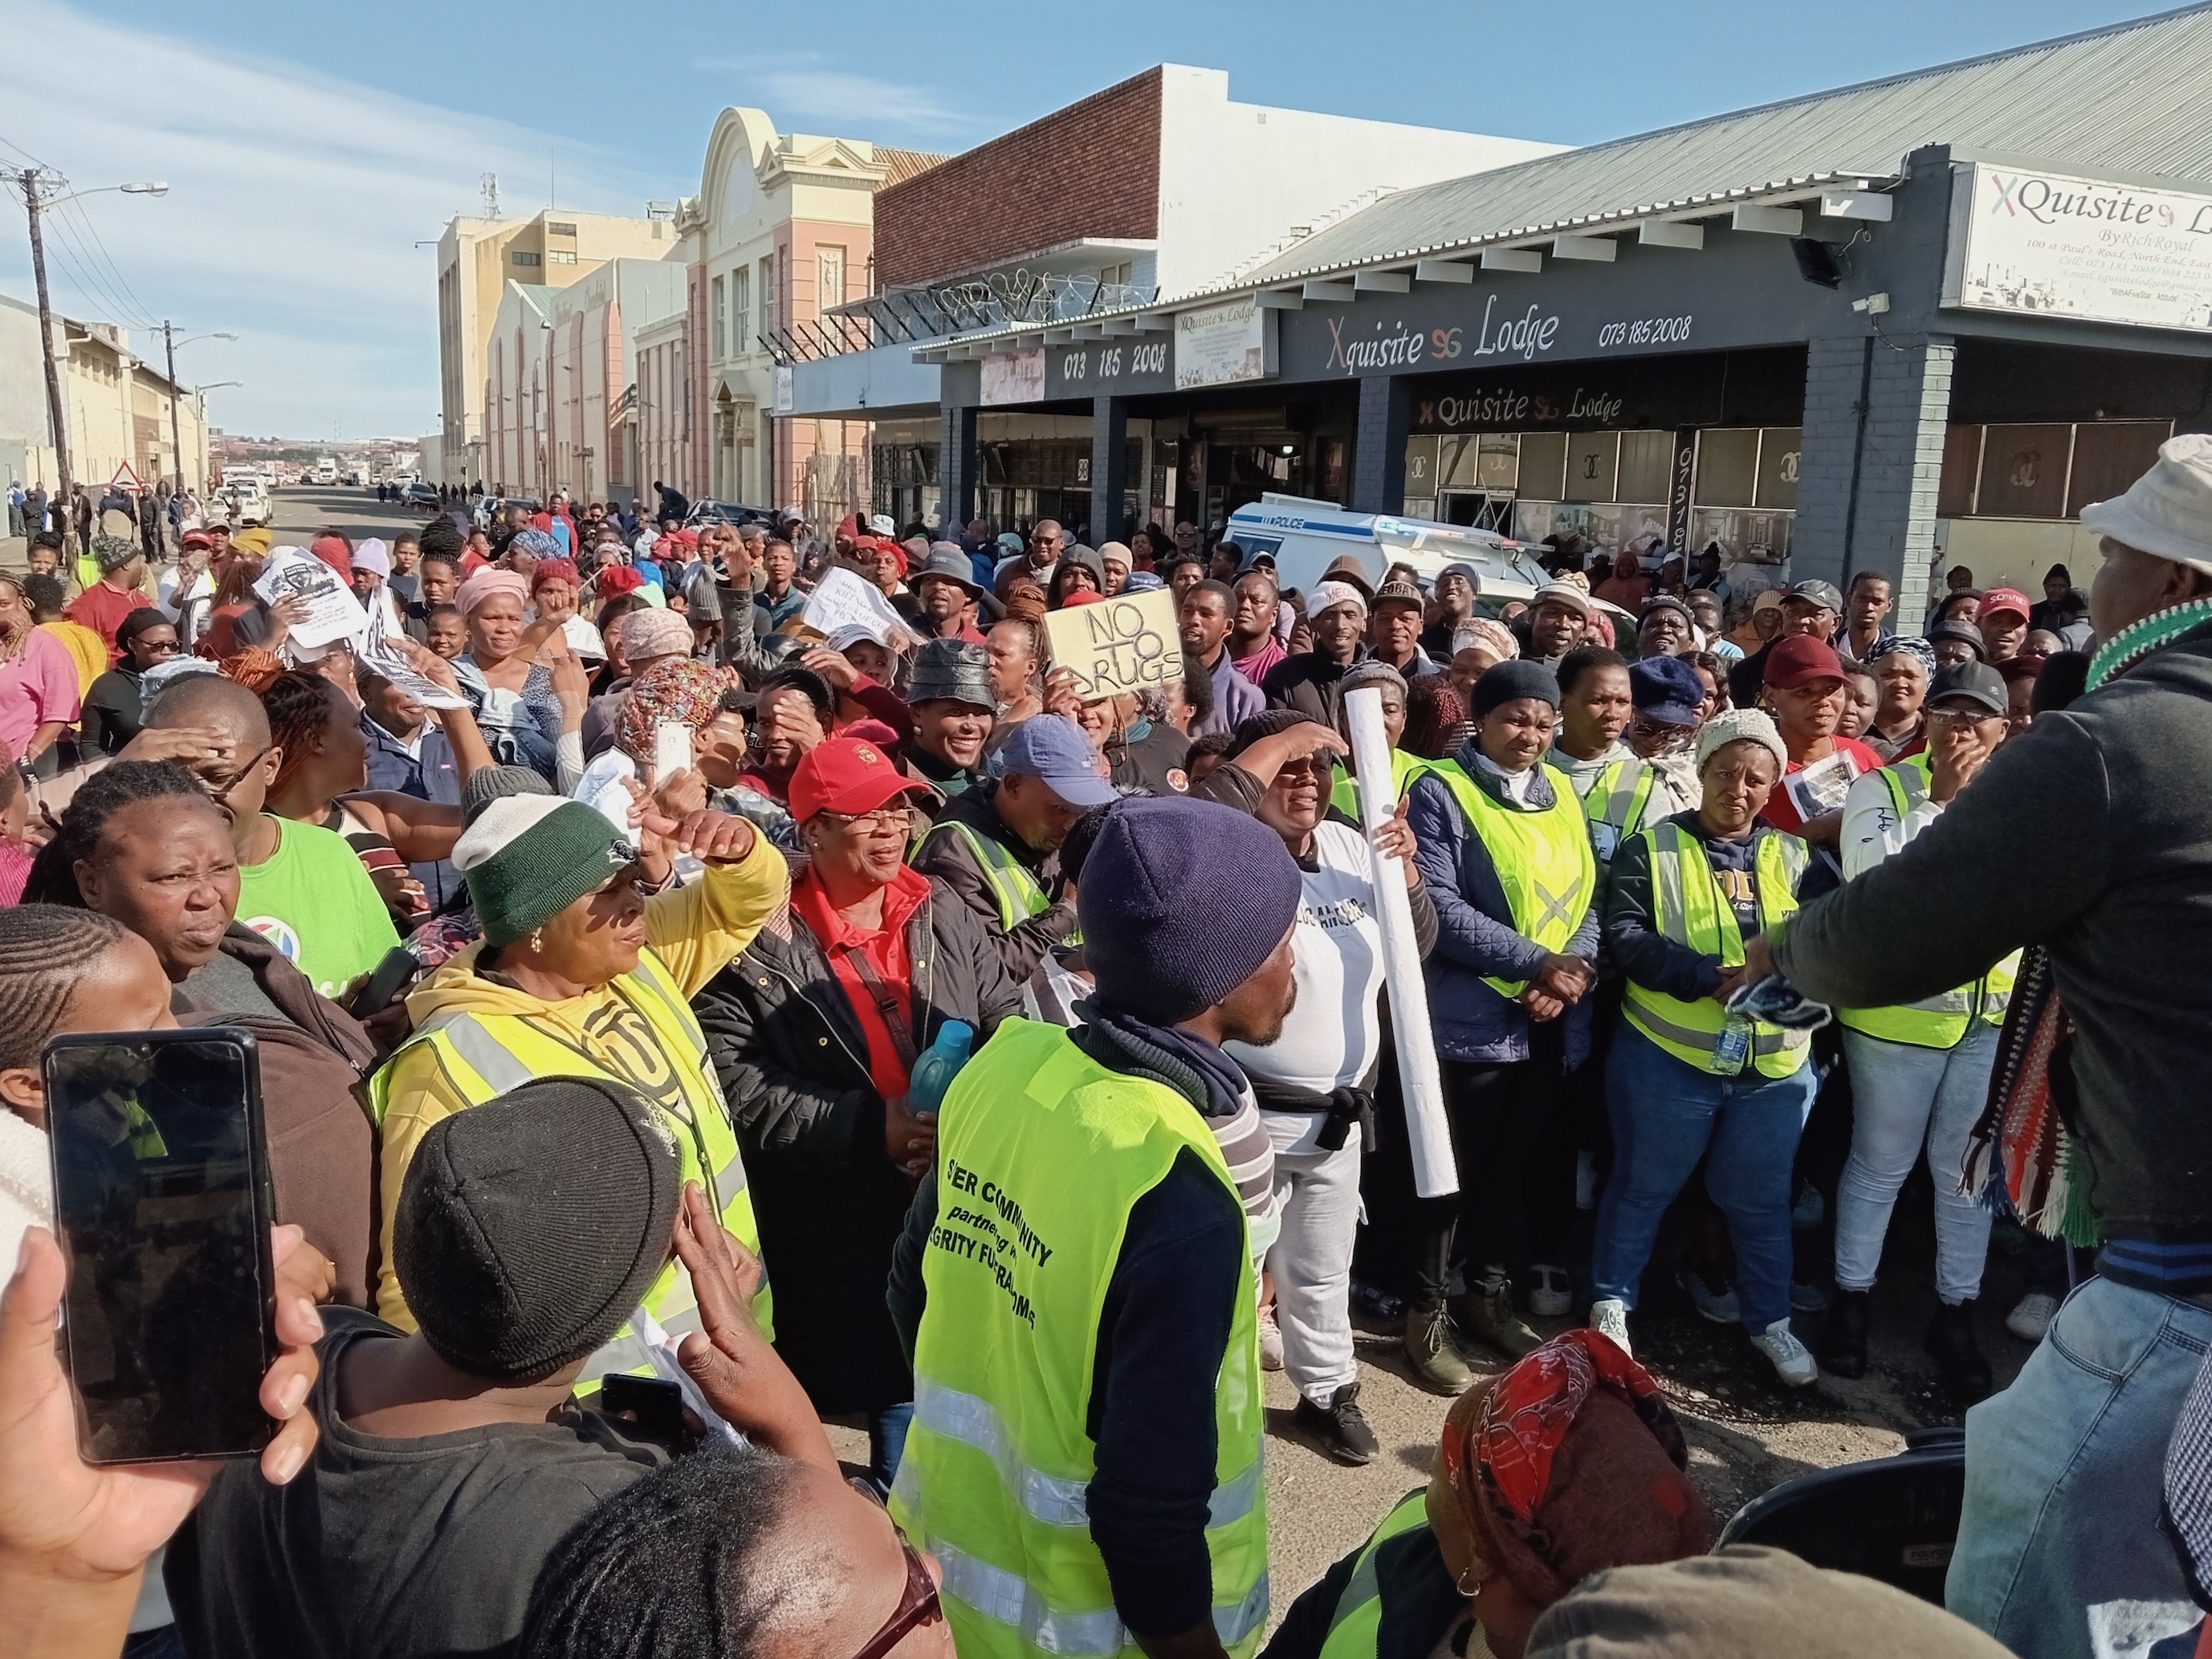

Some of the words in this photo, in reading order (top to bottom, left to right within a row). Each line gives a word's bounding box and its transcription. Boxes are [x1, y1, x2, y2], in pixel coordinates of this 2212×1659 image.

[2026, 239, 2045, 248] 100
[2096, 248, 2126, 259] Road,
[2128, 252, 2160, 263] North
[2162, 256, 2186, 267] End,
[2189, 259, 2211, 268] East
[2098, 229, 2197, 254] ByRichRoyal
[2086, 259, 2105, 268] 073
[2109, 262, 2127, 271] 185
[1227, 302, 1256, 324] Lodge
[1326, 316, 1424, 375] Xquisite
[1473, 294, 1559, 361] Lodge
[1599, 322, 1627, 347] 073
[1627, 319, 1653, 344] 185
[1651, 315, 1693, 344] 2008
[1064, 352, 1086, 380] 073
[1099, 347, 1122, 377] 185
[1131, 343, 1167, 374] 2008
[1566, 387, 1623, 422] Lodge
[1078, 460, 1089, 479] 98
[1273, 516, 1305, 529] POLICE
[1084, 602, 1144, 643] NO
[1094, 630, 1163, 668] TO
[1066, 649, 1183, 695] DRUGS
[981, 1182, 1053, 1268] COMMNITY
